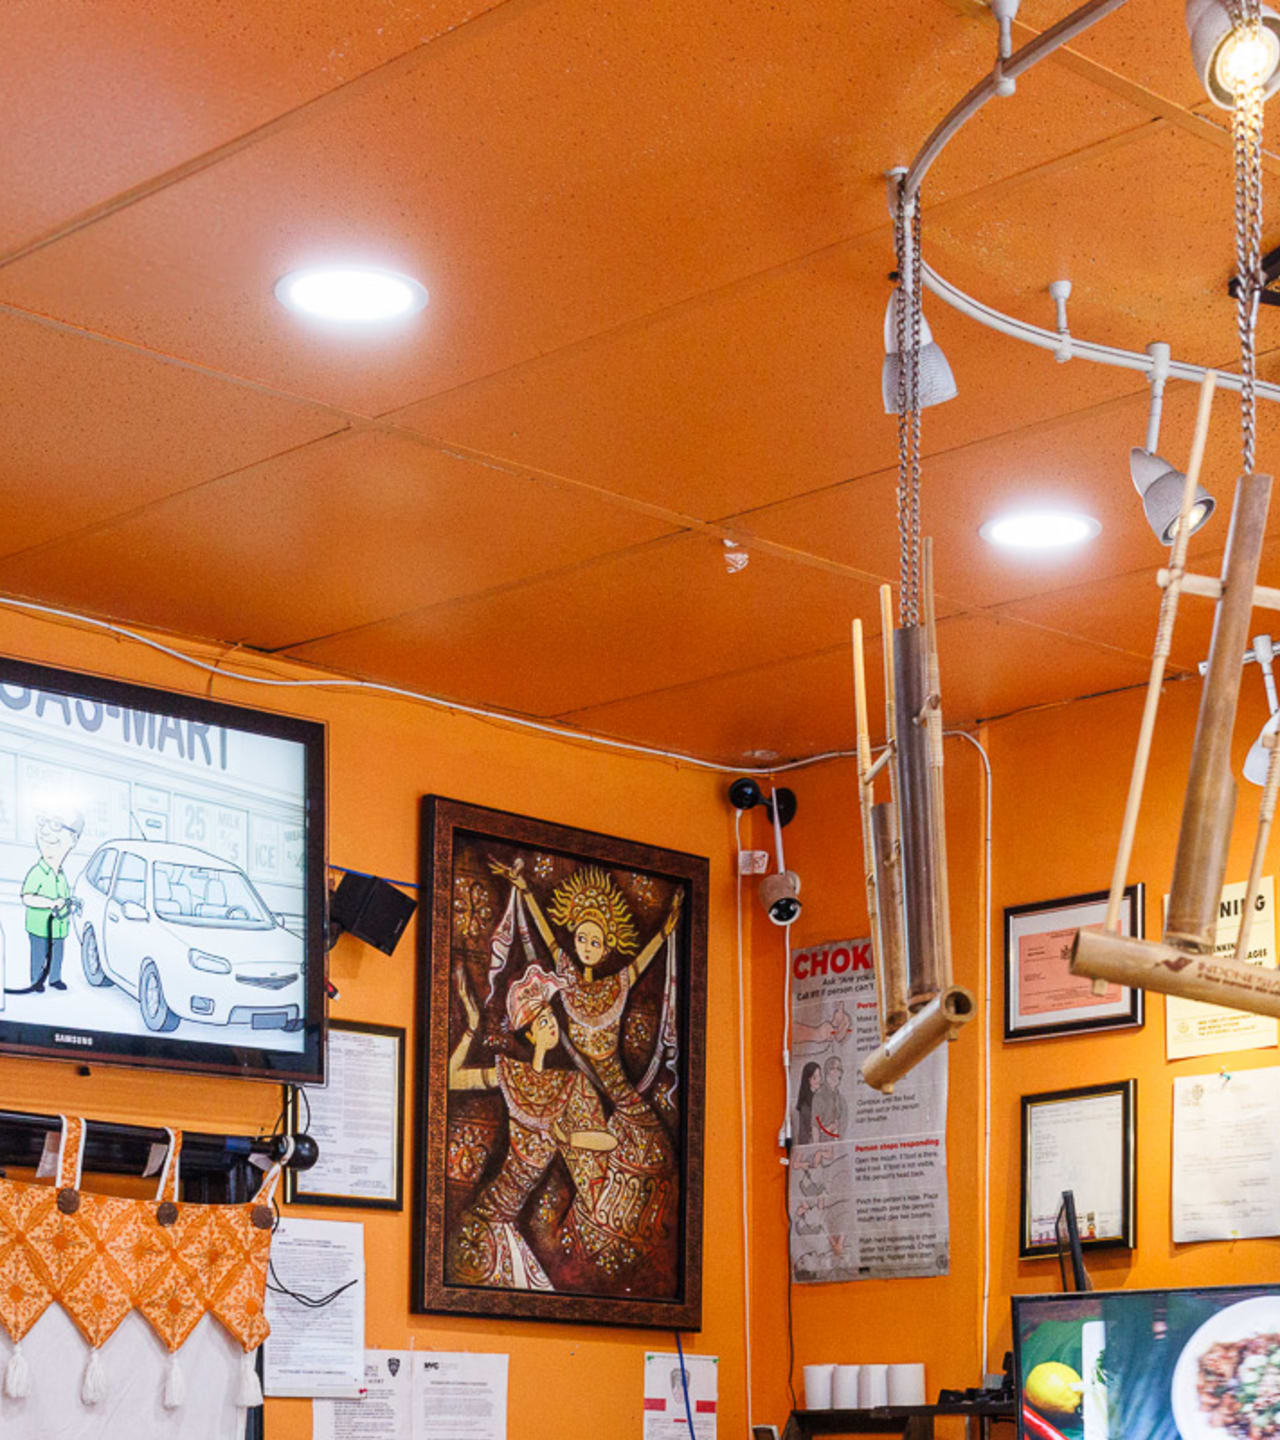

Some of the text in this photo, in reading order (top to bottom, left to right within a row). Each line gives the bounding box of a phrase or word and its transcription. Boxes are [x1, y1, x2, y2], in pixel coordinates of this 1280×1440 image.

[793, 943, 875, 980] CHOK
[827, 986, 853, 996] person
[54, 1033, 94, 1046] SAMSUNG
